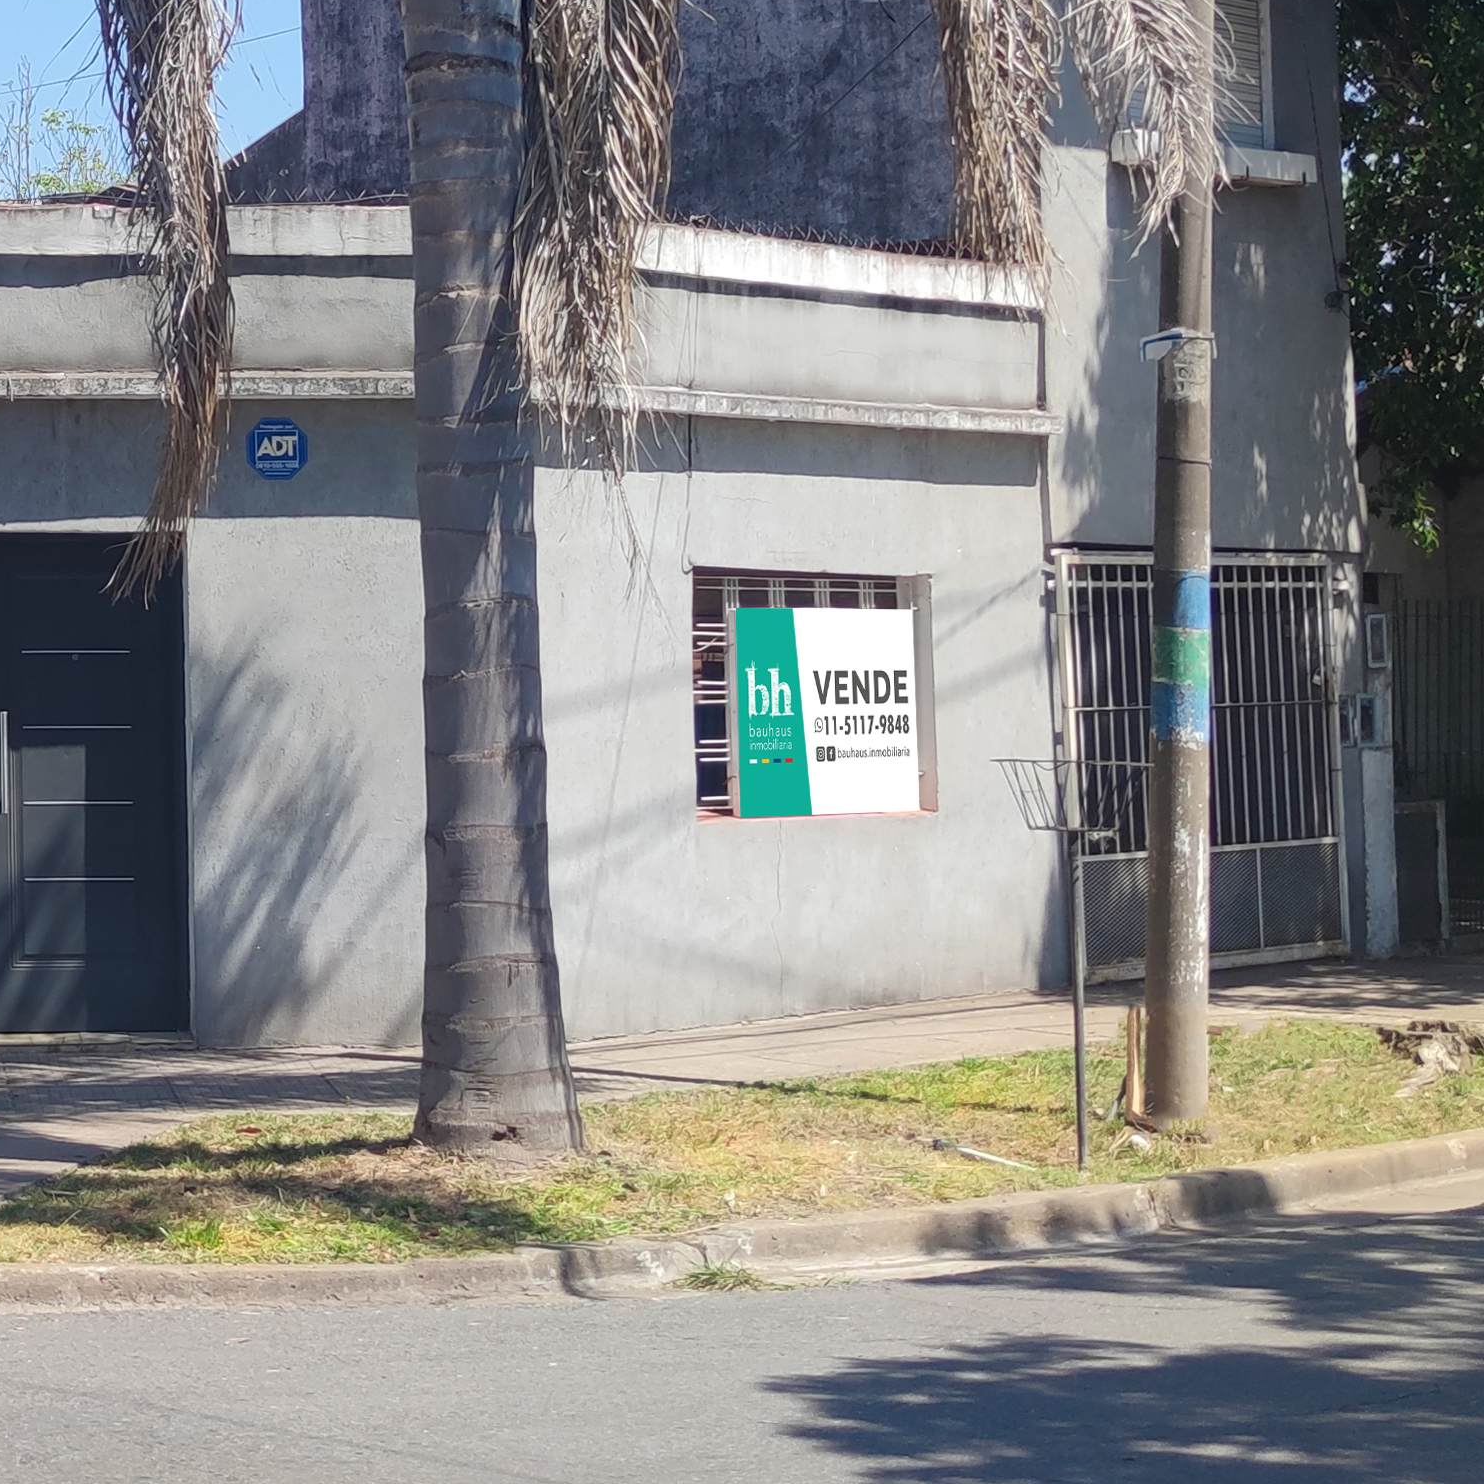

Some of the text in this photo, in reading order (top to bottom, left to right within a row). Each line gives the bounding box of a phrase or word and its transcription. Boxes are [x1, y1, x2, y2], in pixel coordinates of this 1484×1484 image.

[256, 435, 297, 457] ADT
[745, 660, 795, 720] bh
[813, 669, 909, 705] VENDE
[749, 723, 792, 738] bauhaus
[824, 714, 910, 736] 11-5117-9848
[749, 738, 793, 751] inmobiliaria
[837, 746, 911, 759] bauhaus.inmobiliaria
